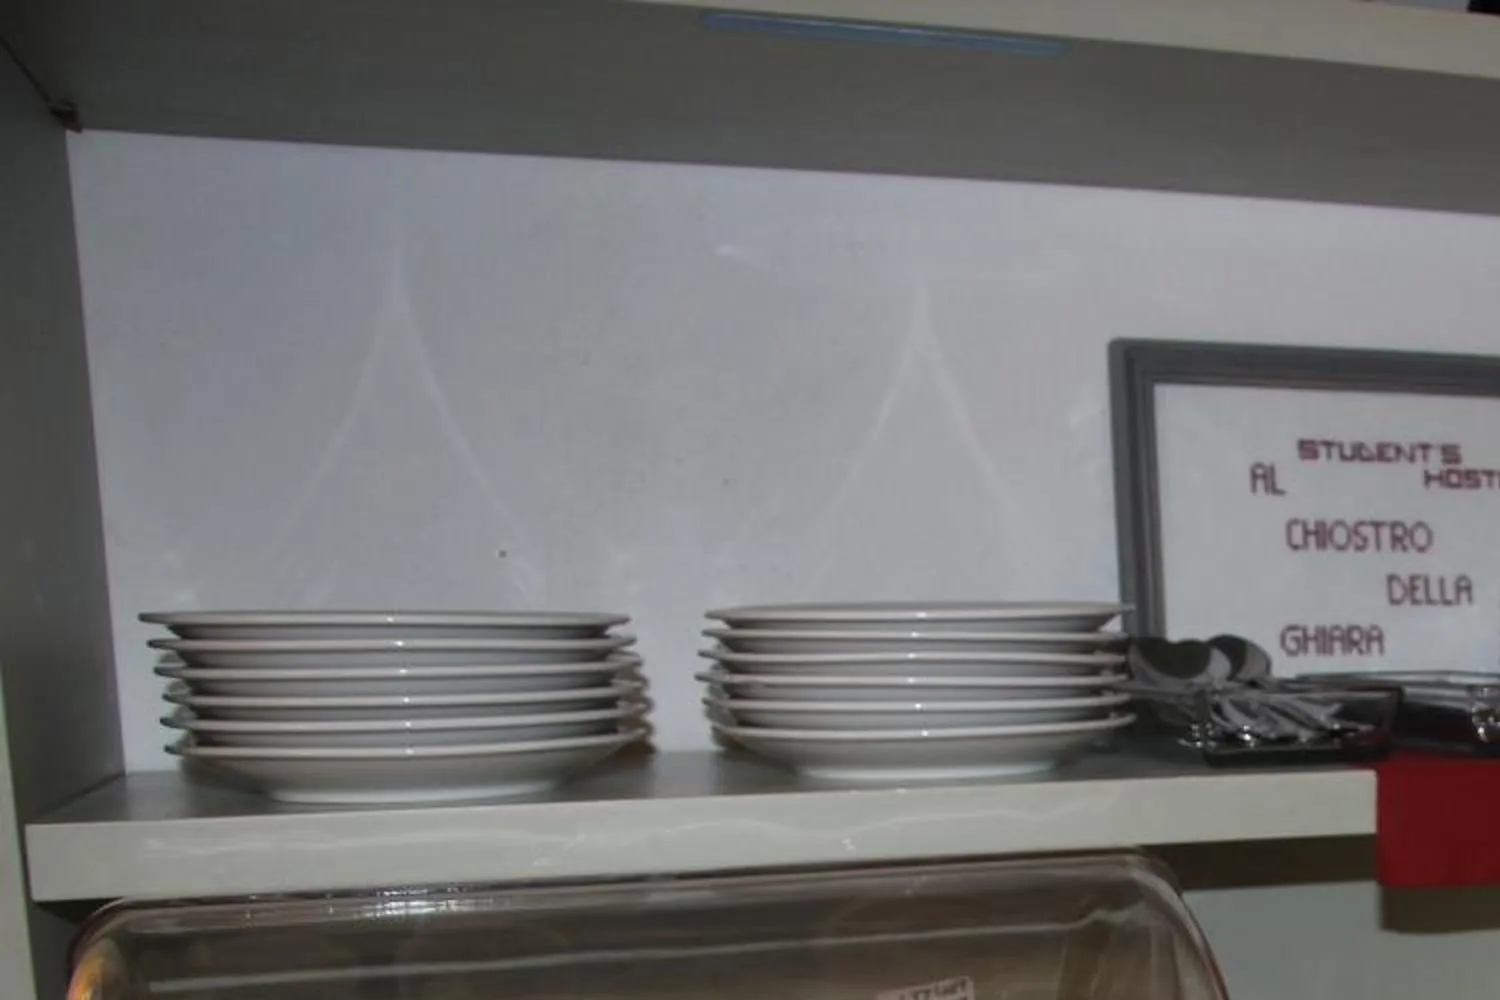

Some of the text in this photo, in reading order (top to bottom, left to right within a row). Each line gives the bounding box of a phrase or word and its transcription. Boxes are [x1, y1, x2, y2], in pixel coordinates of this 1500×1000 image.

[1249, 462, 1286, 496] AL
[1285, 518, 1434, 553] CHIOSTRO
[1387, 572, 1474, 606] DELLA
[1279, 624, 1385, 657] GHIARA
